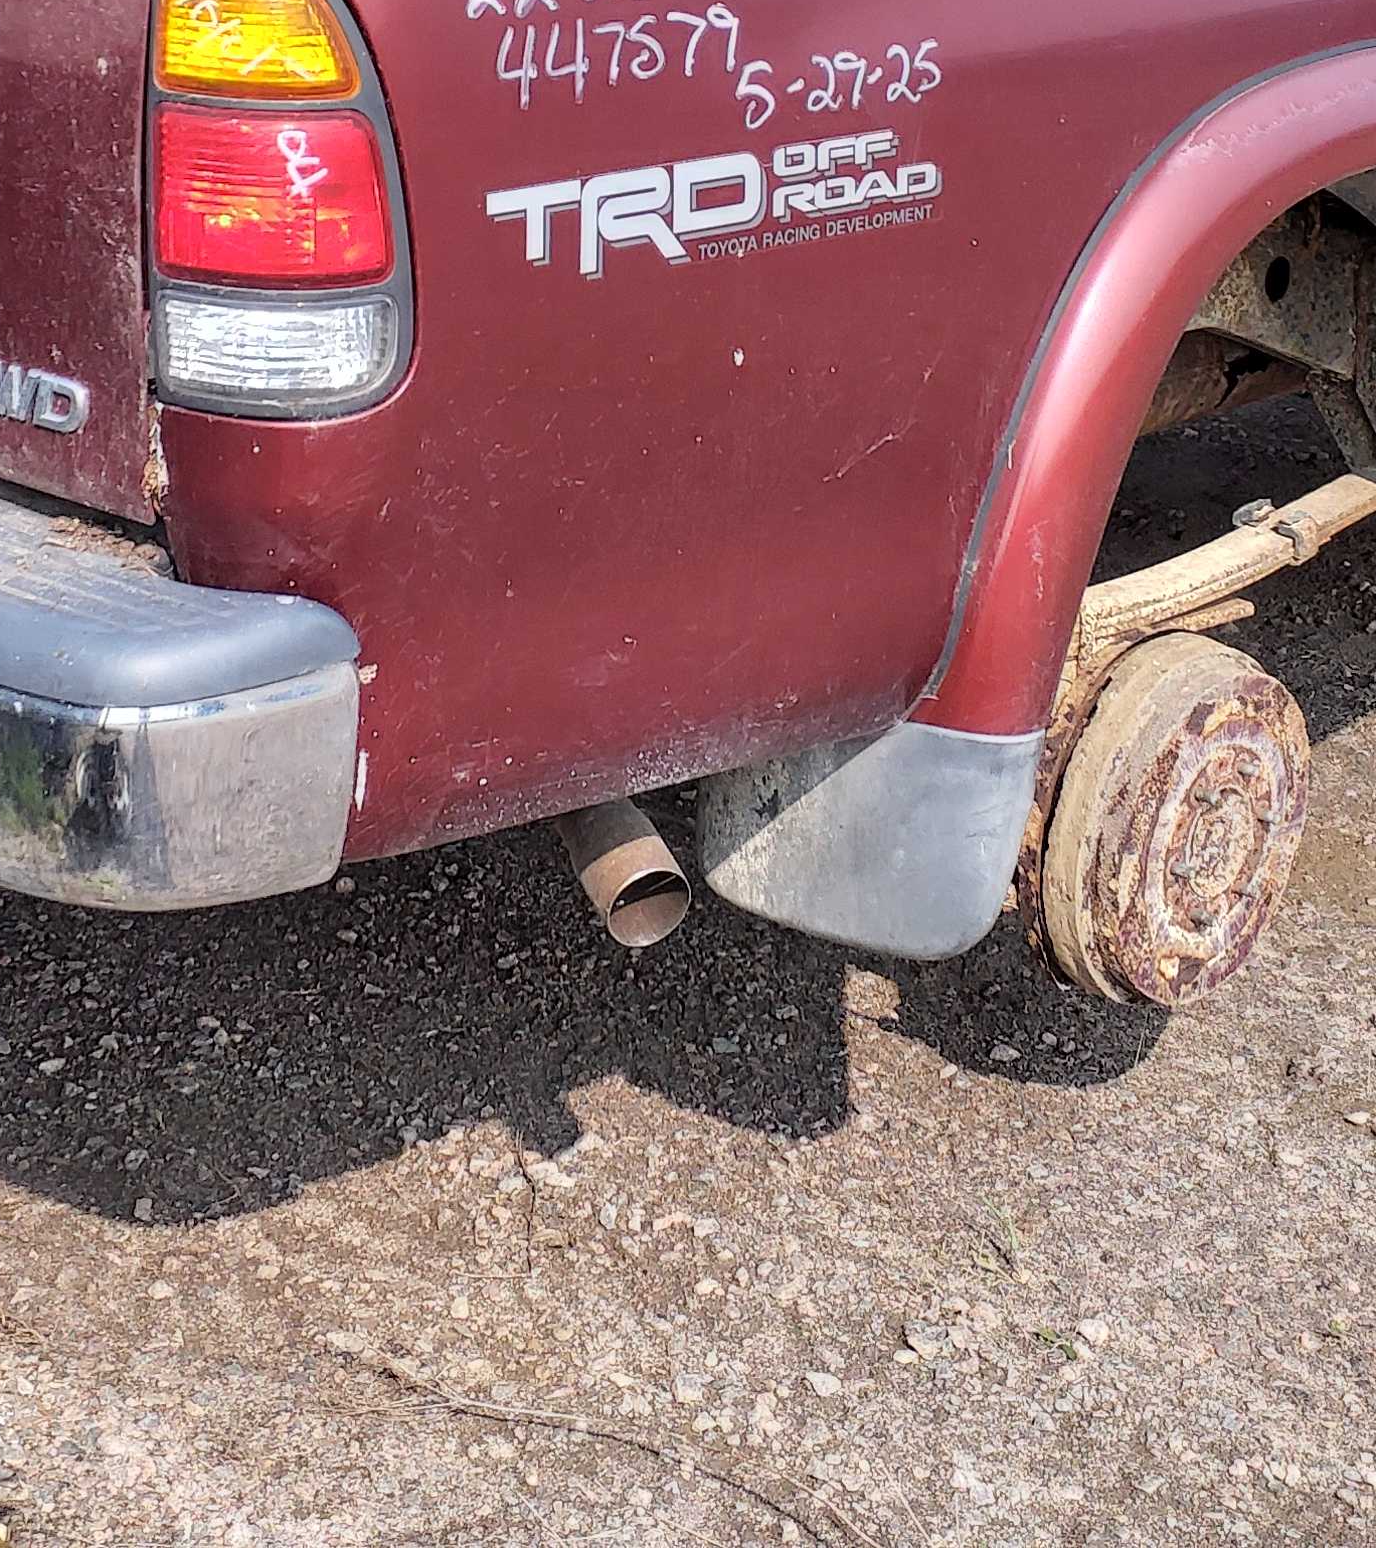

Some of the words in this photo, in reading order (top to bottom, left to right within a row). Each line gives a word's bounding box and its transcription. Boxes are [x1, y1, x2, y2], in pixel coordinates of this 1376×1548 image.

[496, 2, 741, 110] 447579
[734, 38, 943, 130] 5-29-25
[772, 130, 901, 180] OFF
[772, 163, 943, 223] ROAD
[485, 152, 769, 281] TRD
[697, 235, 758, 261] TOYOTA
[761, 223, 822, 249] RACING
[825, 204, 934, 238] DEVELOPMENT
